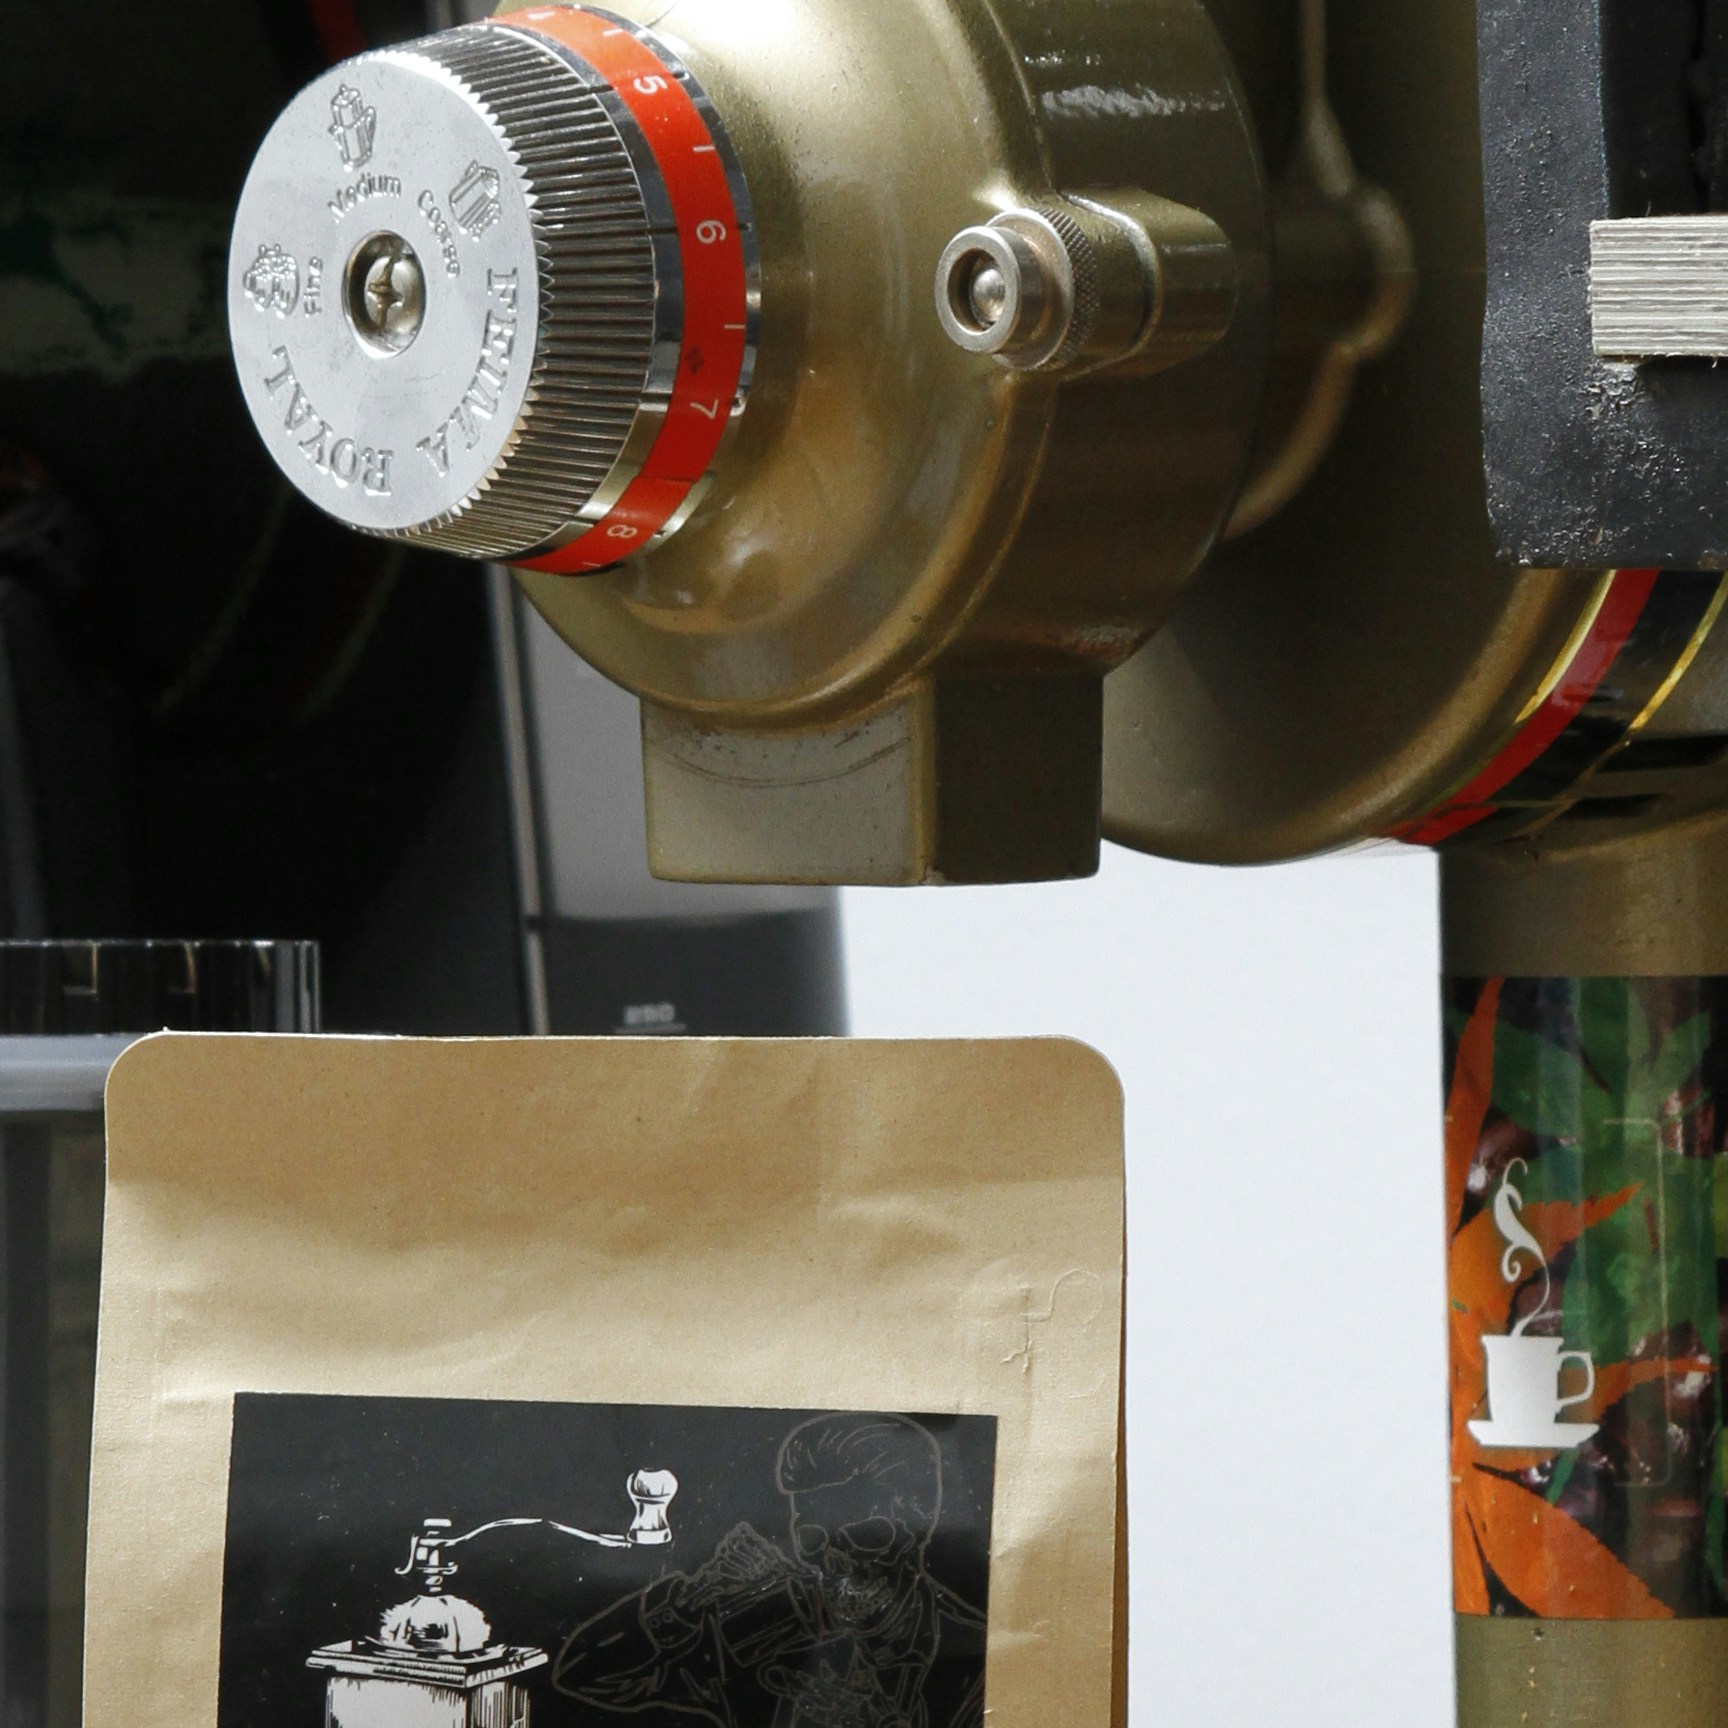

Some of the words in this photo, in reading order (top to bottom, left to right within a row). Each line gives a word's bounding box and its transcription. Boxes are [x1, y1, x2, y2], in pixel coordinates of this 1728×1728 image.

[633, 75, 669, 96] 5
[328, 172, 403, 225] Medium
[696, 218, 728, 245] 6
[303, 256, 324, 318] Fine
[264, 345, 395, 496] ROYAL
[690, 397, 720, 422] 7
[607, 522, 639, 541] 8
